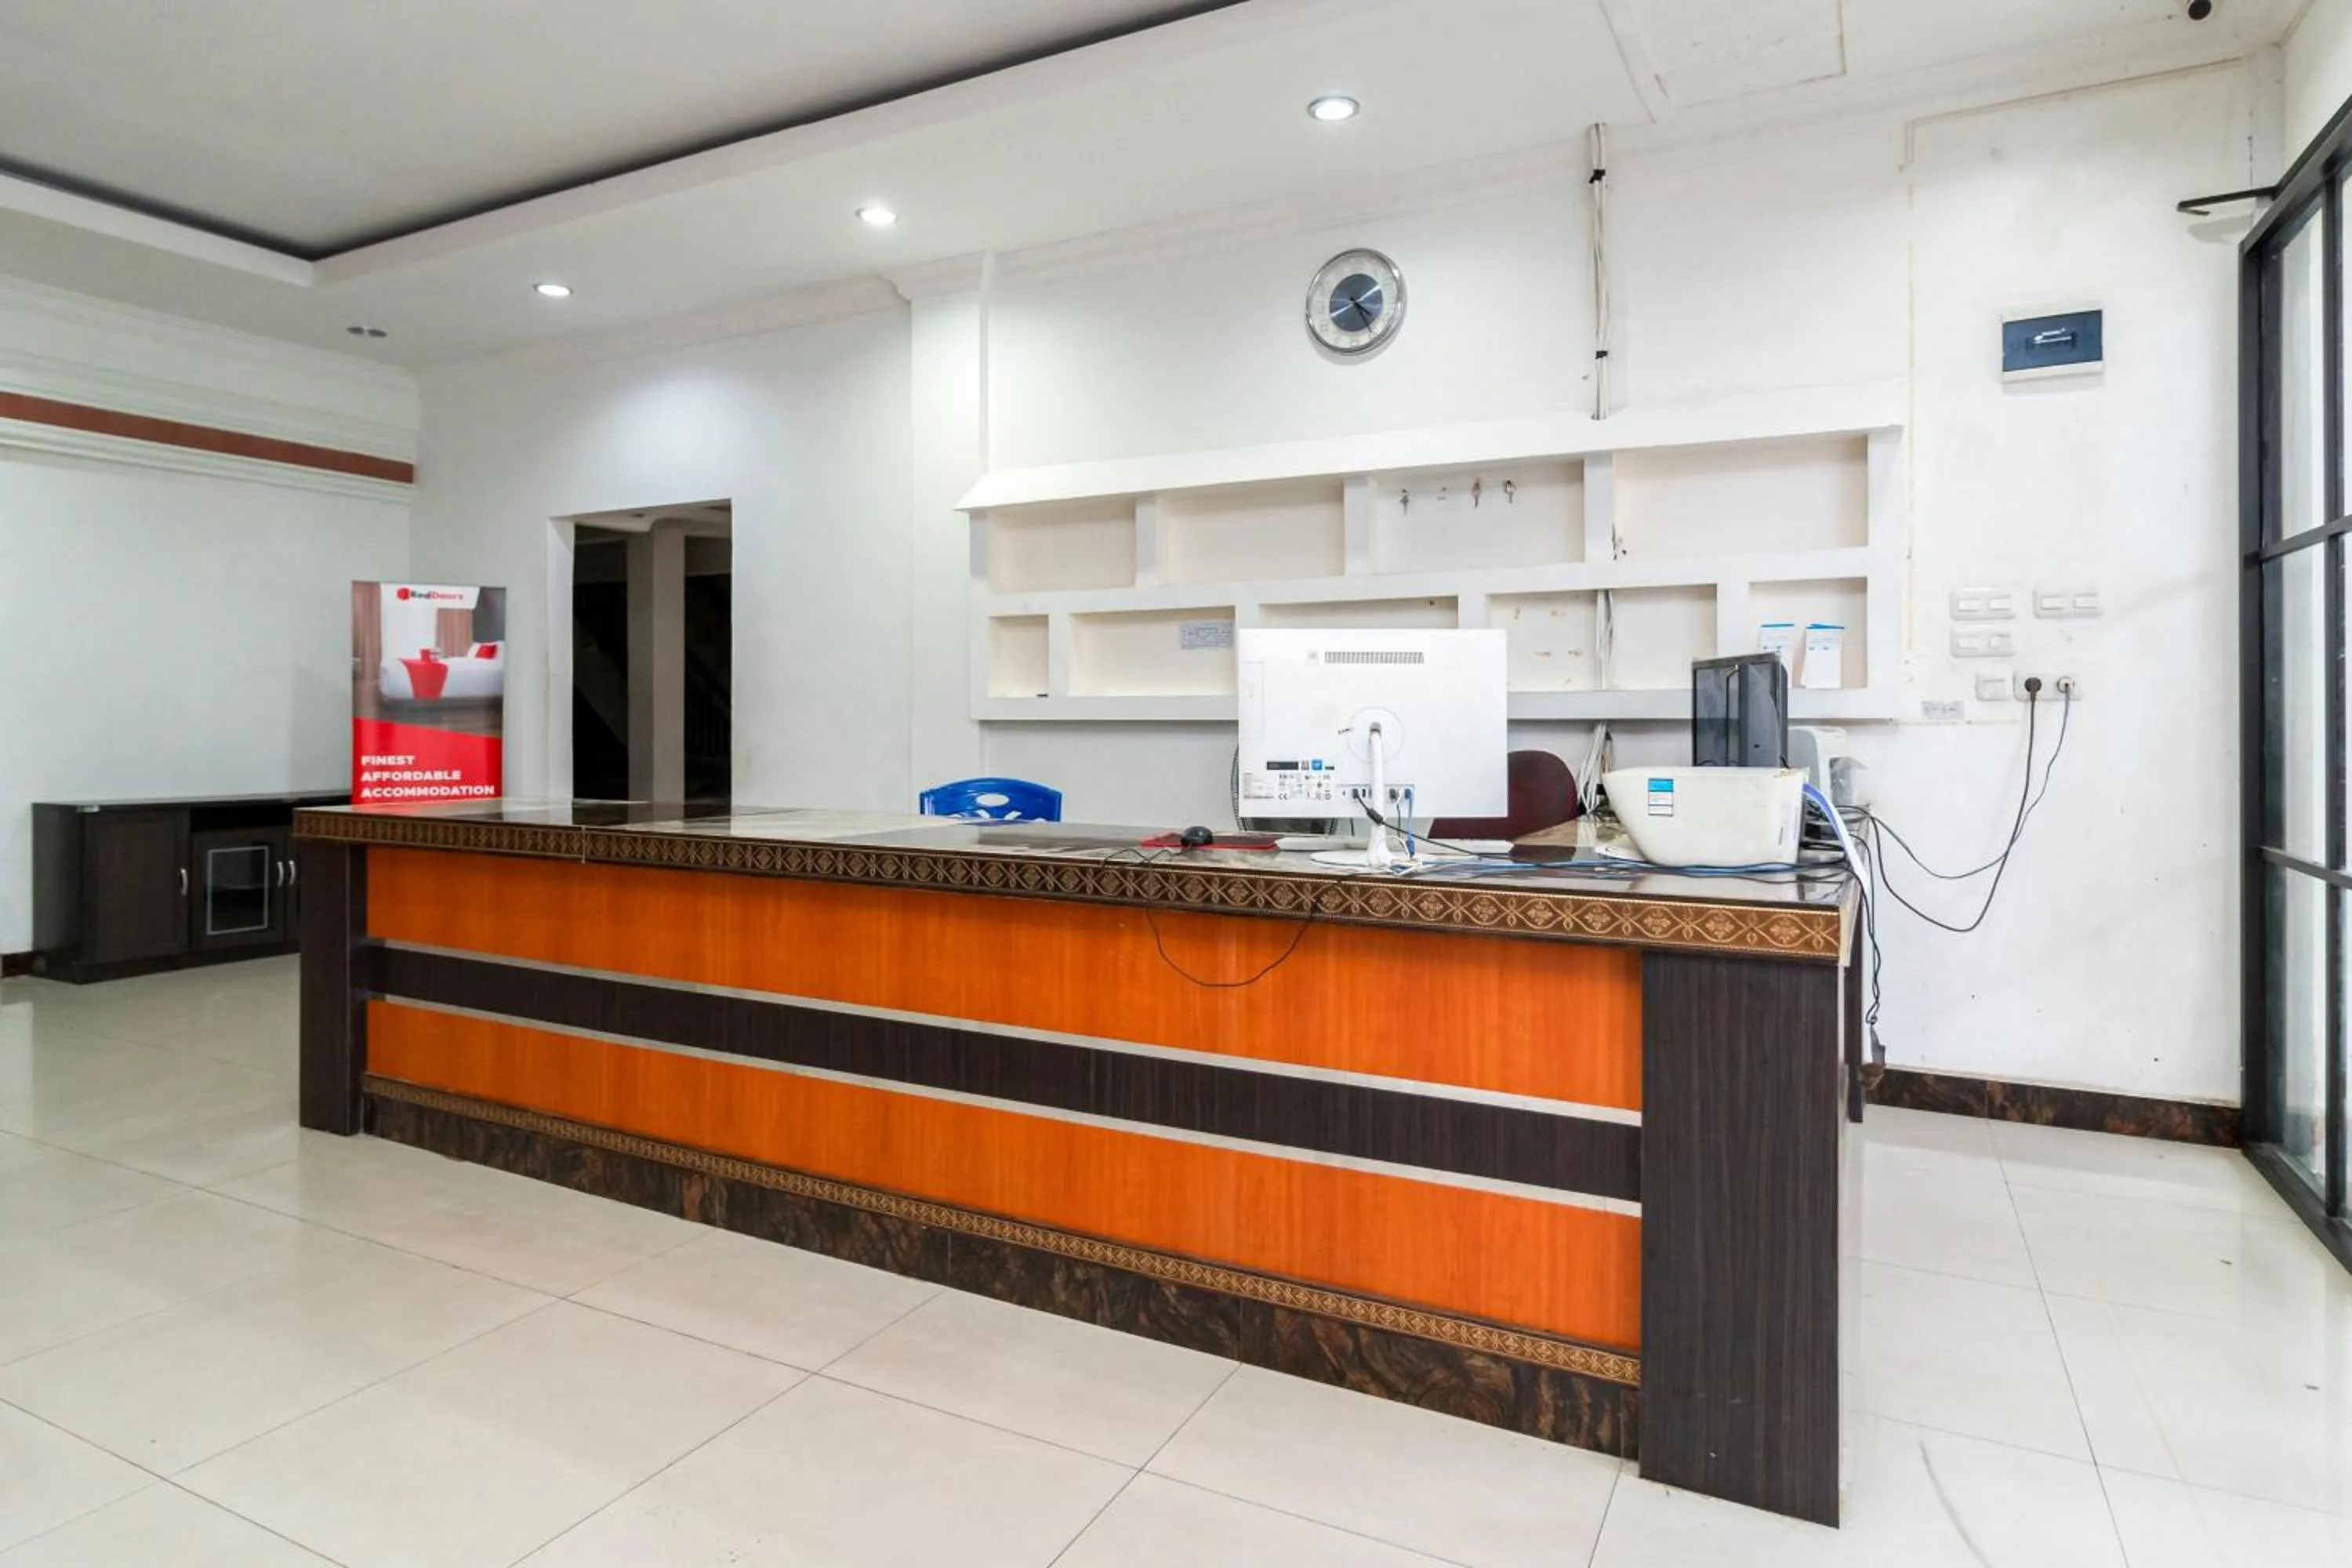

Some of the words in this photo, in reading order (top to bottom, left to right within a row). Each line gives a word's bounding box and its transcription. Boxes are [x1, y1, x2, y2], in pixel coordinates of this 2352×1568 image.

[361, 755, 415, 766] FINEST
[361, 770, 462, 782] AFFORDABLE
[361, 786, 495, 798] ACCOMMODATION
